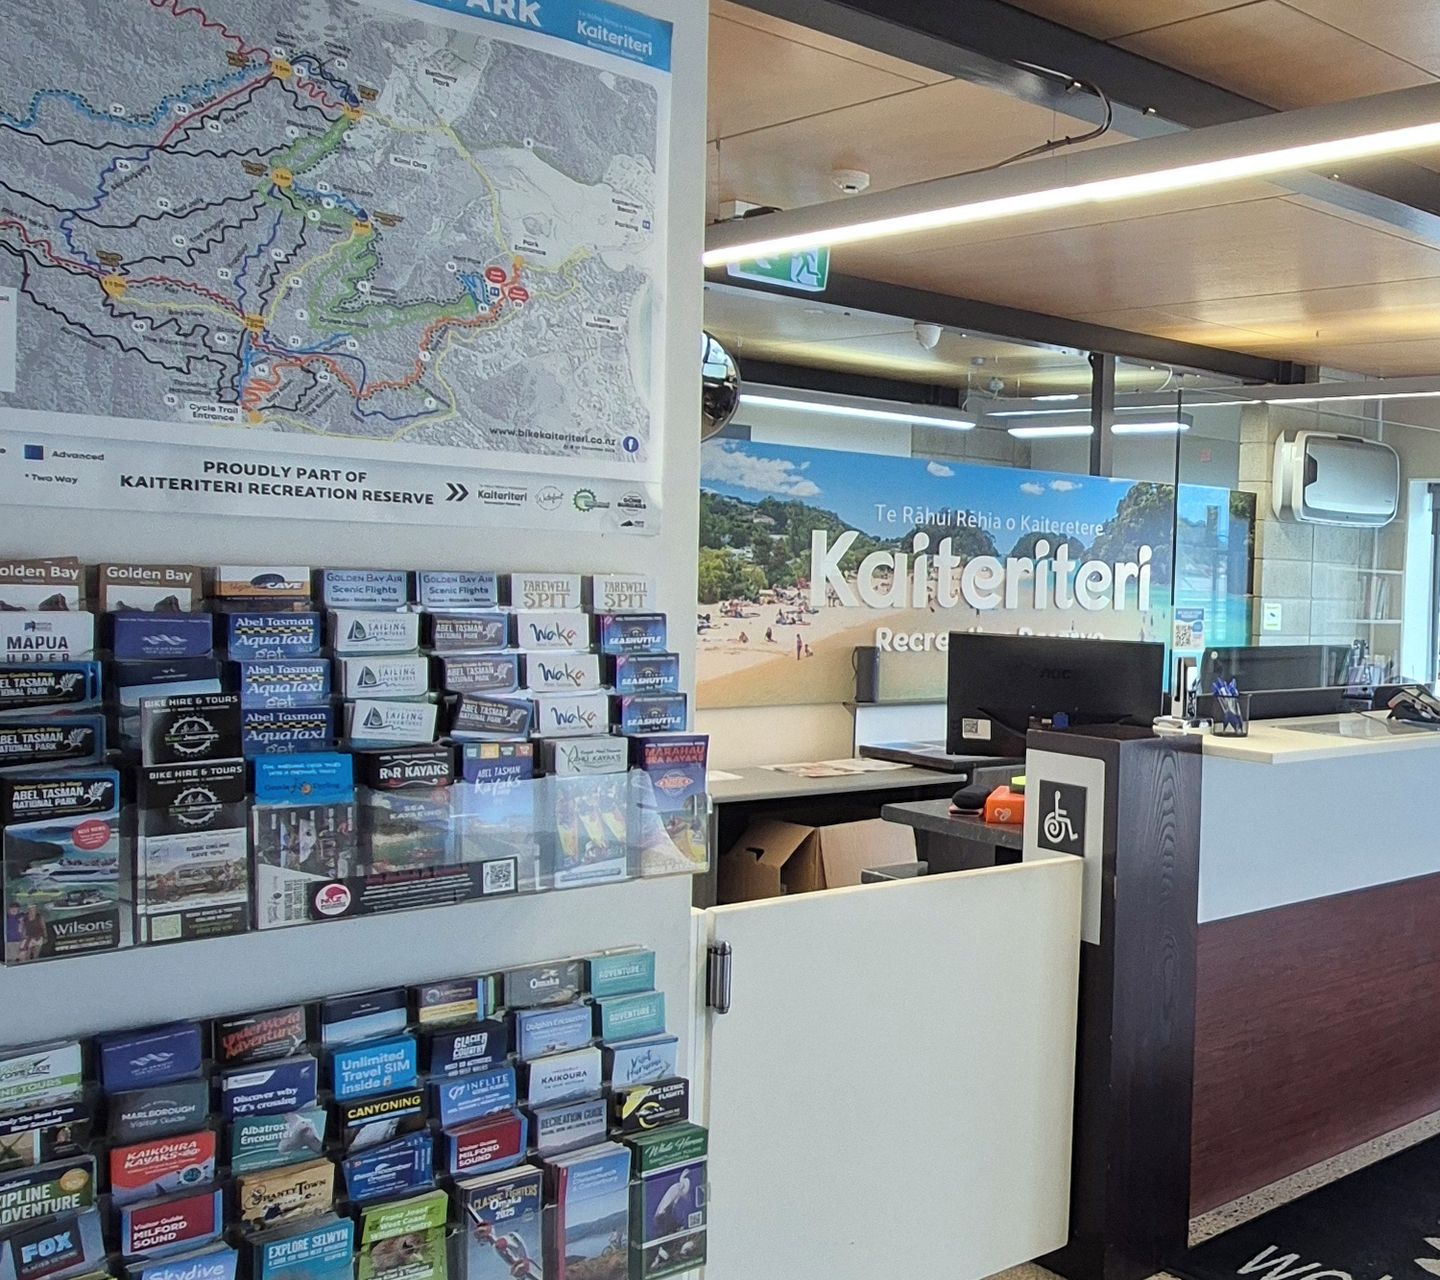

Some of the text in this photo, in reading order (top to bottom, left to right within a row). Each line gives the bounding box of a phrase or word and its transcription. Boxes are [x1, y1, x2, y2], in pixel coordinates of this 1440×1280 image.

[576, 19, 652, 56] Kaiteriteri
[189, 403, 239, 414] Cycle Trail
[192, 412, 235, 422] Entrance
[489, 427, 616, 446] www.bikekaiteriteri.co.nz
[52, 450, 105, 461] Advanced
[203, 460, 368, 483] PROUDLY PART OF
[32, 474, 78, 485] Two Way
[120, 474, 434, 505] KAITERITERI RECREATION RESERVE
[478, 489, 527, 502] Kaiteriteri
[875, 504, 1104, 537] Te Rāhui Rēhia o Kaiteretere
[50, 567, 79, 580] Bay
[107, 566, 192, 583] Golden Bay
[326, 573, 363, 582] GOLDEN
[367, 574, 386, 582] BAY
[811, 530, 1152, 611] Kaiteriteri
[423, 574, 457, 583] GOLDEN
[460, 574, 475, 583] BAY
[332, 585, 397, 595] Scenic Flights
[429, 586, 489, 595] Scenic Flights
[524, 580, 570, 592] FAREWELL
[605, 581, 648, 593] FAREWELL
[524, 593, 570, 608] SPIT
[605, 594, 648, 608] SPIT
[236, 617, 313, 627] Abel Tasman
[368, 623, 406, 631] SAILING
[236, 633, 313, 648] AquaTaxi
[530, 622, 577, 646] Waka
[7, 636, 68, 649] MAPUA
[248, 665, 324, 674] Abel Tasman
[378, 667, 416, 676] SAILING
[538, 662, 585, 686] Waka
[15, 675, 56, 687] TASMAN
[247, 680, 324, 696] AquaTaxi
[145, 695, 238, 708] BIKE HIRE & TOURS
[246, 712, 326, 722] Abel Tasman
[385, 712, 423, 721] SAILING
[551, 706, 597, 728] Waka
[22, 731, 63, 743] TASMAN
[244, 727, 325, 744] AquaTaxi
[645, 747, 705, 756] MARAHAU
[593, 755, 621, 763] KAYAKS
[150, 766, 242, 780] BIKE HIRE & TOURS
[404, 765, 449, 778] KAYAKS
[478, 765, 521, 778] ABEL TASMAN
[13, 786, 84, 801] ABEL TASMAN
[13, 797, 77, 810] NATIONAL PARK
[53, 919, 113, 936] Wilsons
[530, 977, 559, 989] Omaka
[454, 1032, 487, 1048] GLACIER
[342, 1050, 404, 1071] Unlimited
[342, 1059, 410, 1083] Travel SIM
[342, 1080, 380, 1094] inside
[467, 1073, 509, 1091] INFLITE
[233, 1087, 298, 1105] Discover why
[233, 1096, 297, 1113] NZ's crossing
[348, 1096, 421, 1119] CANYONING
[122, 1104, 195, 1121] MARLBOROUGH
[541, 1109, 582, 1129] RECREATION
[584, 1106, 603, 1120] GUIDE
[130, 1120, 157, 1129] Visitor
[459, 1144, 499, 1160] MILFORD
[124, 1152, 177, 1168] KAYAKS
[459, 1153, 492, 1166] SOUND
[495, 1207, 515, 1220] 2025
[380, 1214, 426, 1229] West Coast
[133, 1221, 187, 1241] MILFORD
[21, 1231, 73, 1264] FOX
[133, 1232, 177, 1249] SOUND
[268, 1228, 348, 1259] EXPLORE SELWYN
